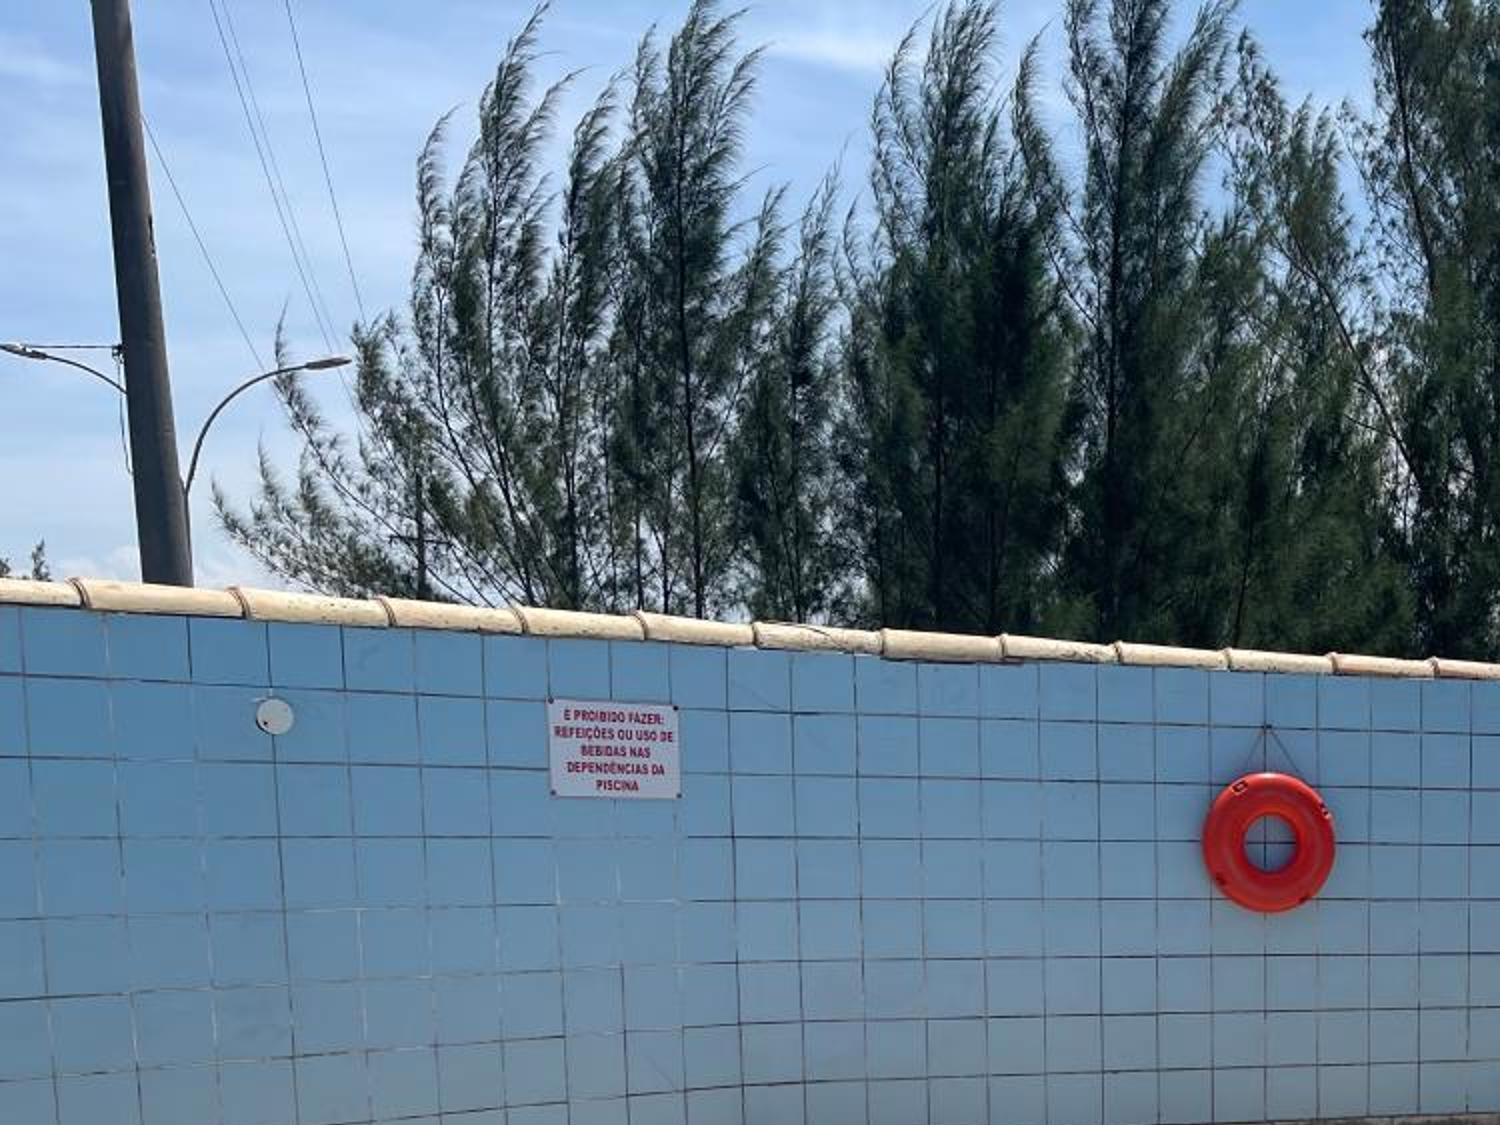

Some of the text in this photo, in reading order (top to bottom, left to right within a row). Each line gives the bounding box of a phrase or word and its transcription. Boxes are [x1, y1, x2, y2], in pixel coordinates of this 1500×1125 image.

[574, 709, 625, 722] PROIBIDO
[554, 725, 673, 742] REFEIÇÕES OU USO DE
[581, 745, 651, 759] BEBIDAS NAS
[567, 760, 665, 776] DEPENDÊNCIAS DA
[596, 778, 639, 791] PISCINA
